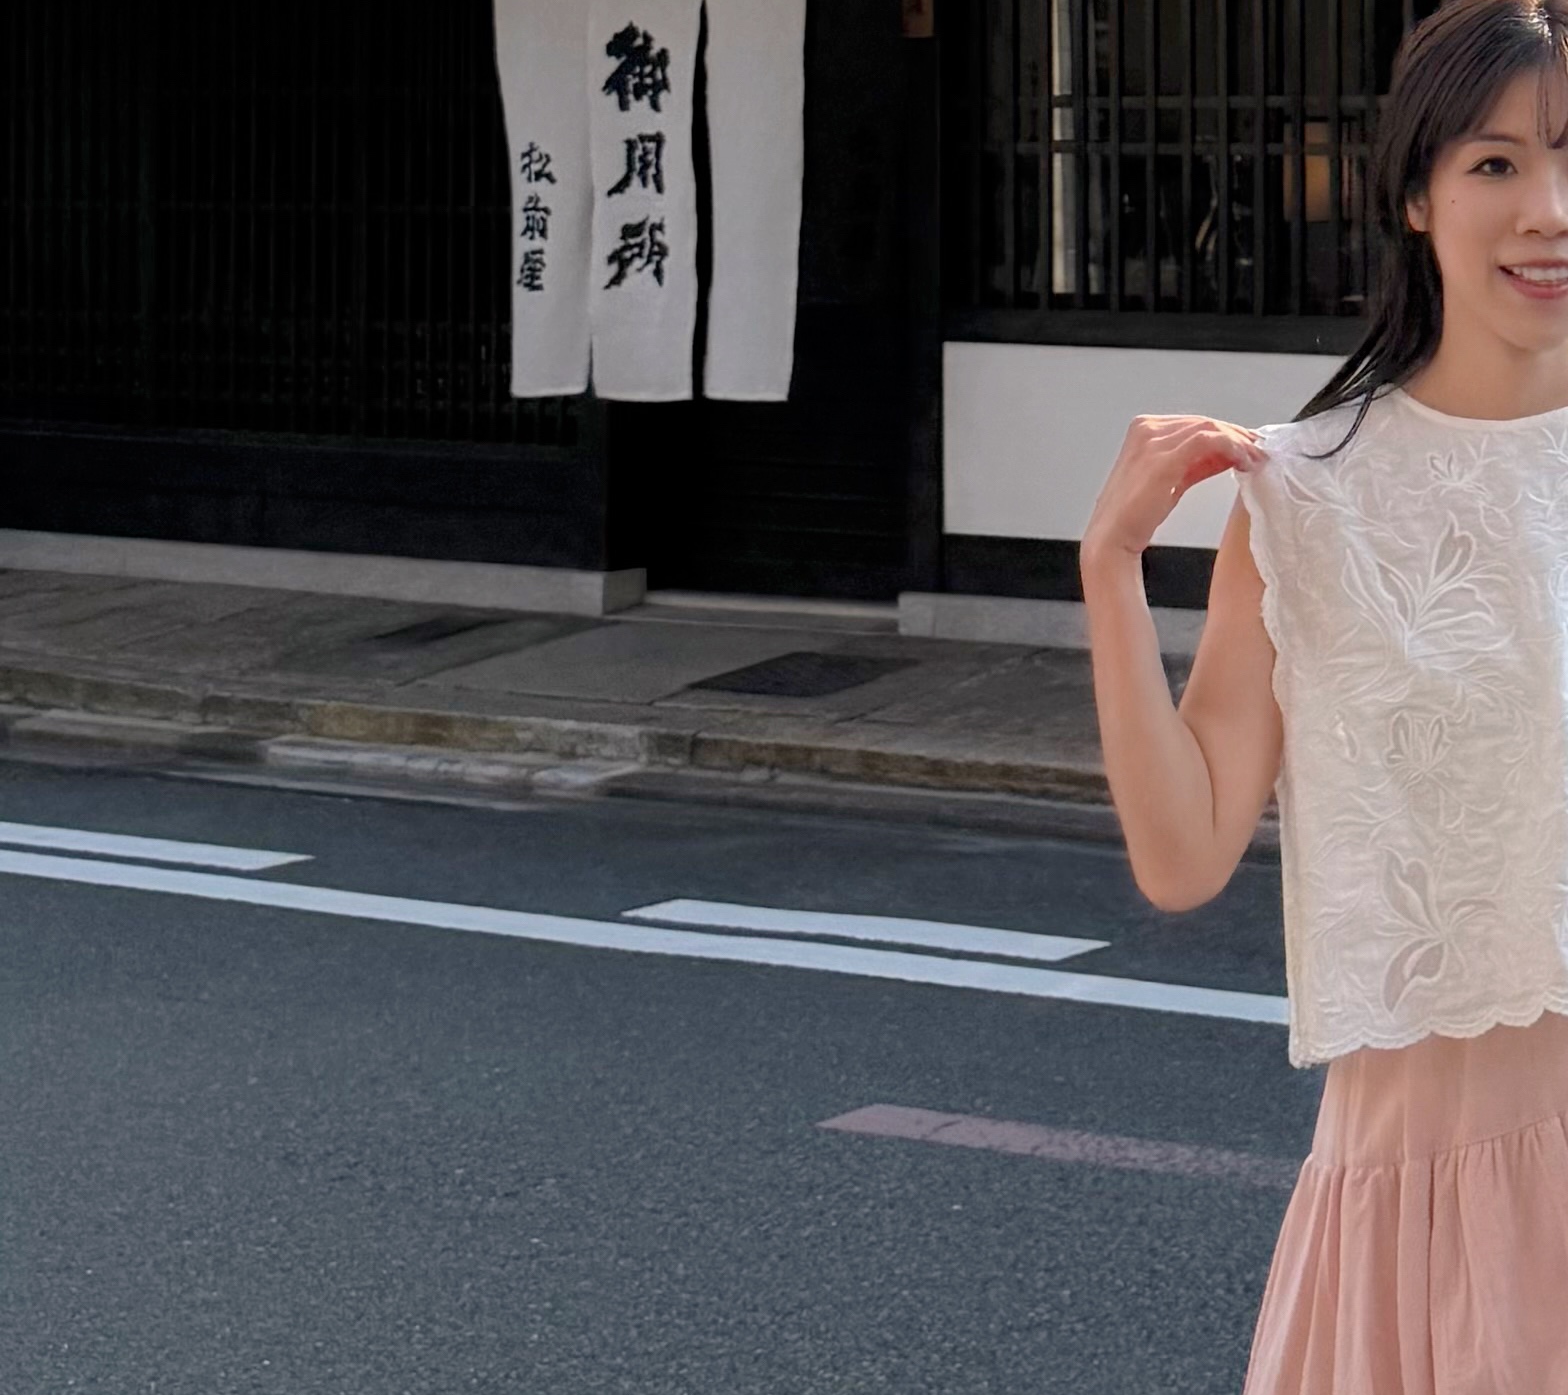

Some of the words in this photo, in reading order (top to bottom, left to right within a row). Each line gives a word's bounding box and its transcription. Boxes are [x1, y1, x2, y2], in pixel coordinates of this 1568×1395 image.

[516, 142, 557, 292] 松前屋
[601, 20, 671, 290] 御用所
